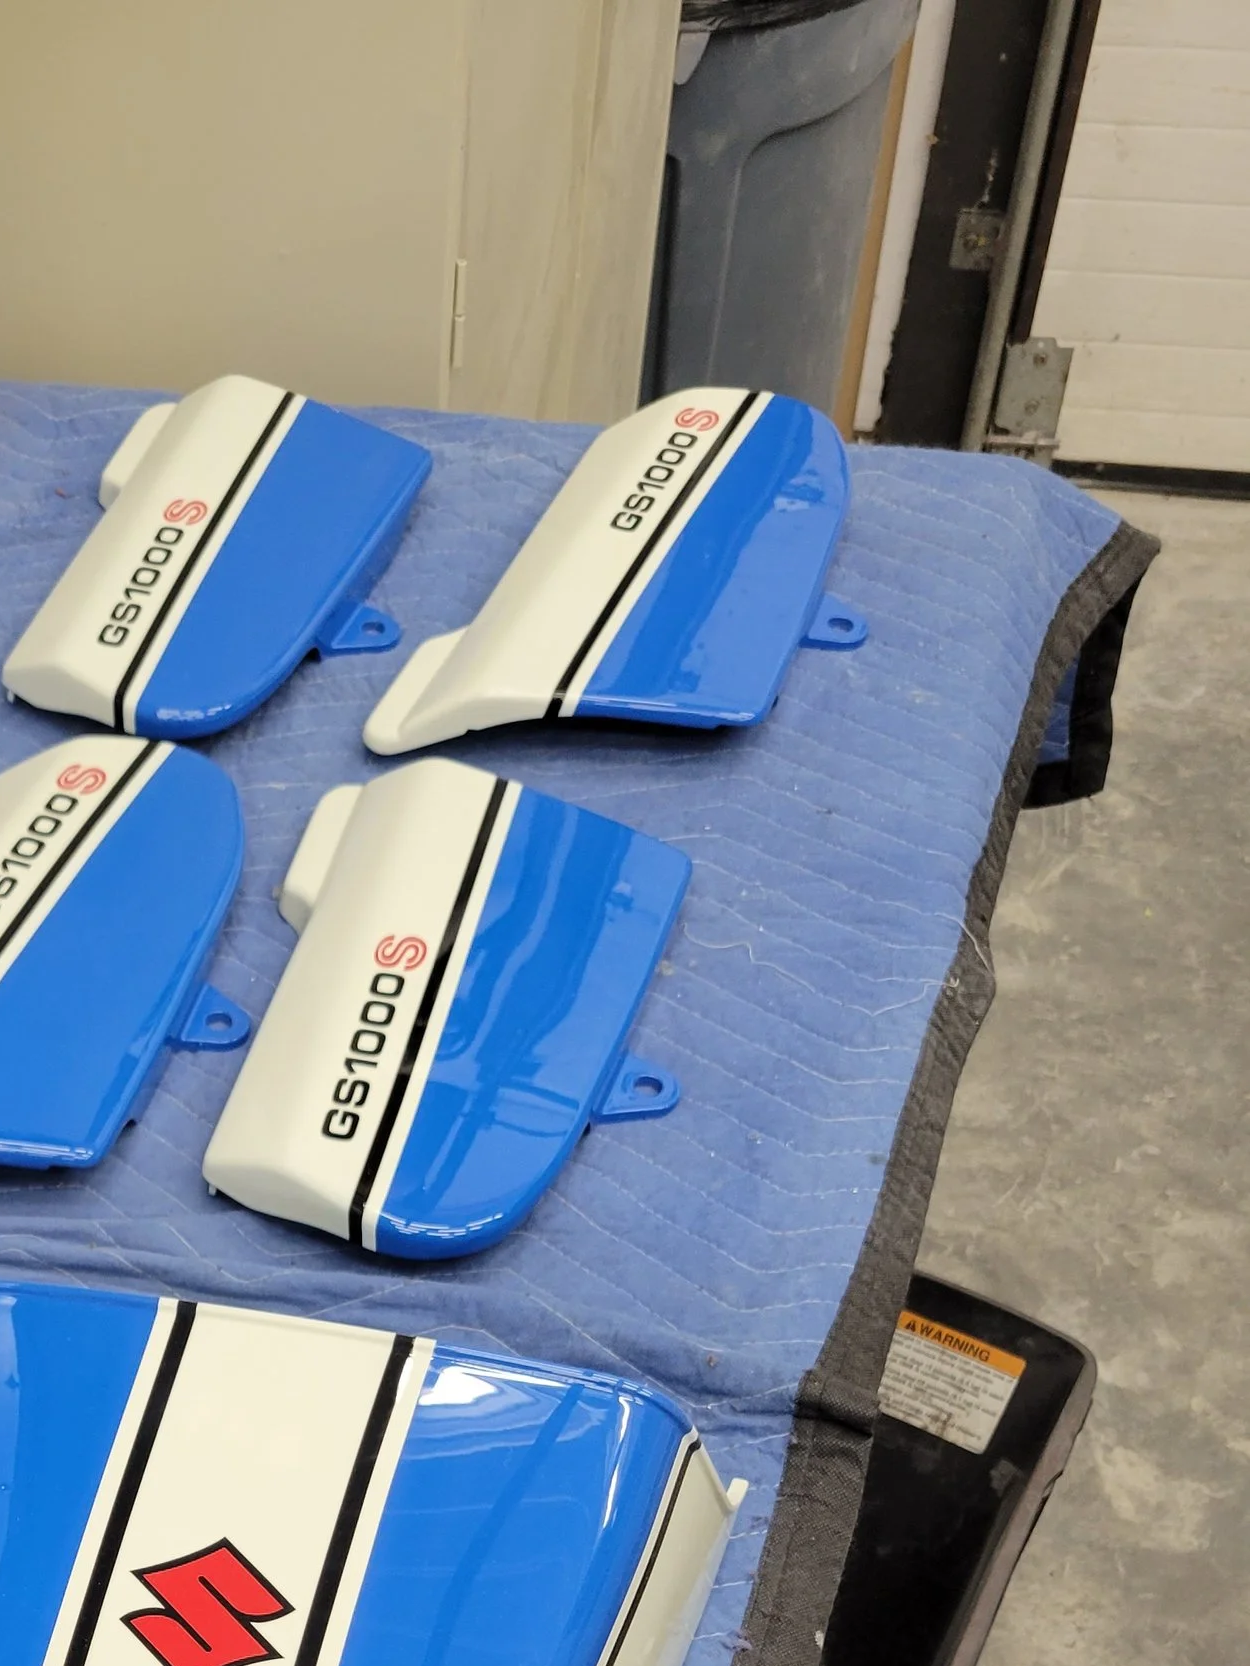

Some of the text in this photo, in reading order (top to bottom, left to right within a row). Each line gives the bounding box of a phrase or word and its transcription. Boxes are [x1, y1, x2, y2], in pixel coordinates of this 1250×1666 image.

[610, 407, 720, 532] GS1000S
[97, 498, 209, 648] GS1000S
[322, 933, 428, 1141] GS1000S
[918, 1323, 991, 1362] WARNING
